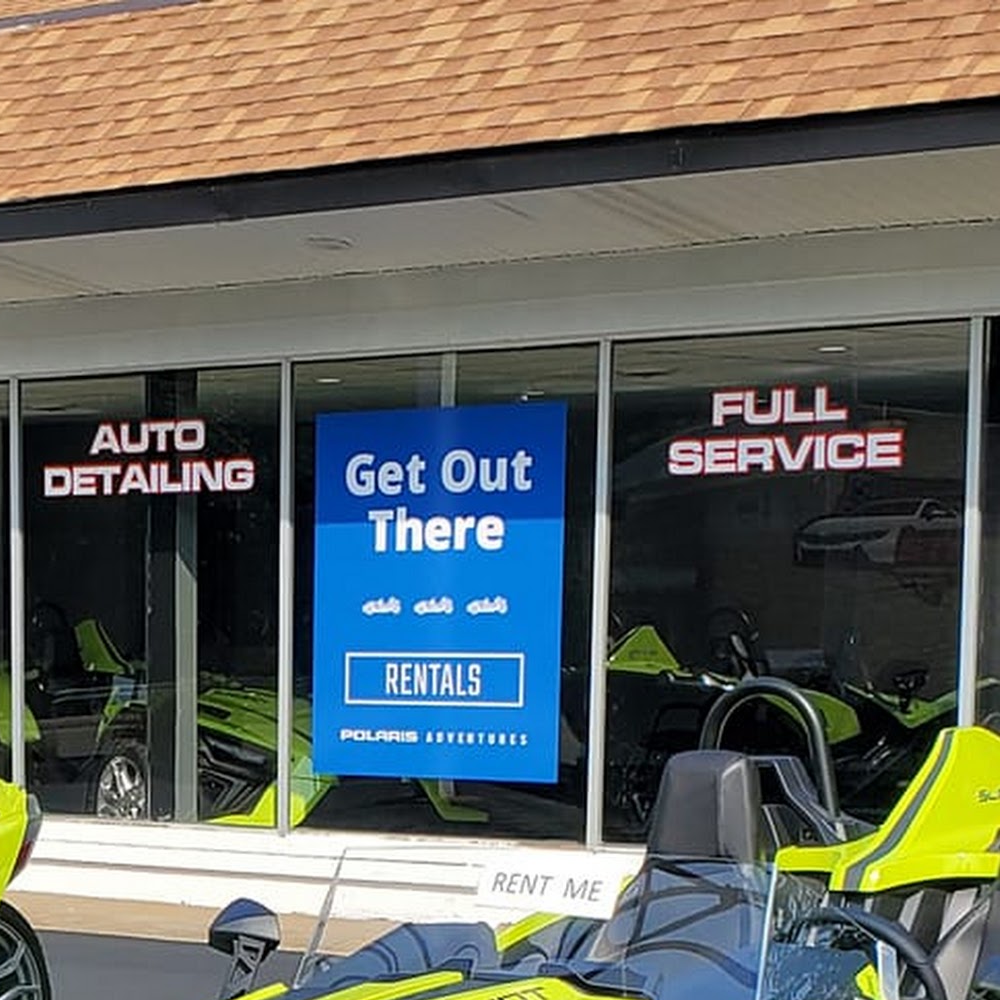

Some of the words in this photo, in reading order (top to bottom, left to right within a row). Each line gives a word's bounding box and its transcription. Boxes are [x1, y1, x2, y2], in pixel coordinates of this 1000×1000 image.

[711, 384, 848, 427] FULL
[89, 419, 206, 455] AUTO
[667, 430, 903, 475] SERVICE
[43, 459, 255, 497] DETAILING
[345, 453, 426, 496] Get
[441, 449, 533, 493] Out
[367, 506, 505, 553] There
[385, 663, 482, 696] RENTALS
[340, 728, 419, 743] POLARIS
[425, 731, 528, 746] ADVENTURES
[492, 871, 554, 896] RENT
[563, 877, 604, 902] ME
